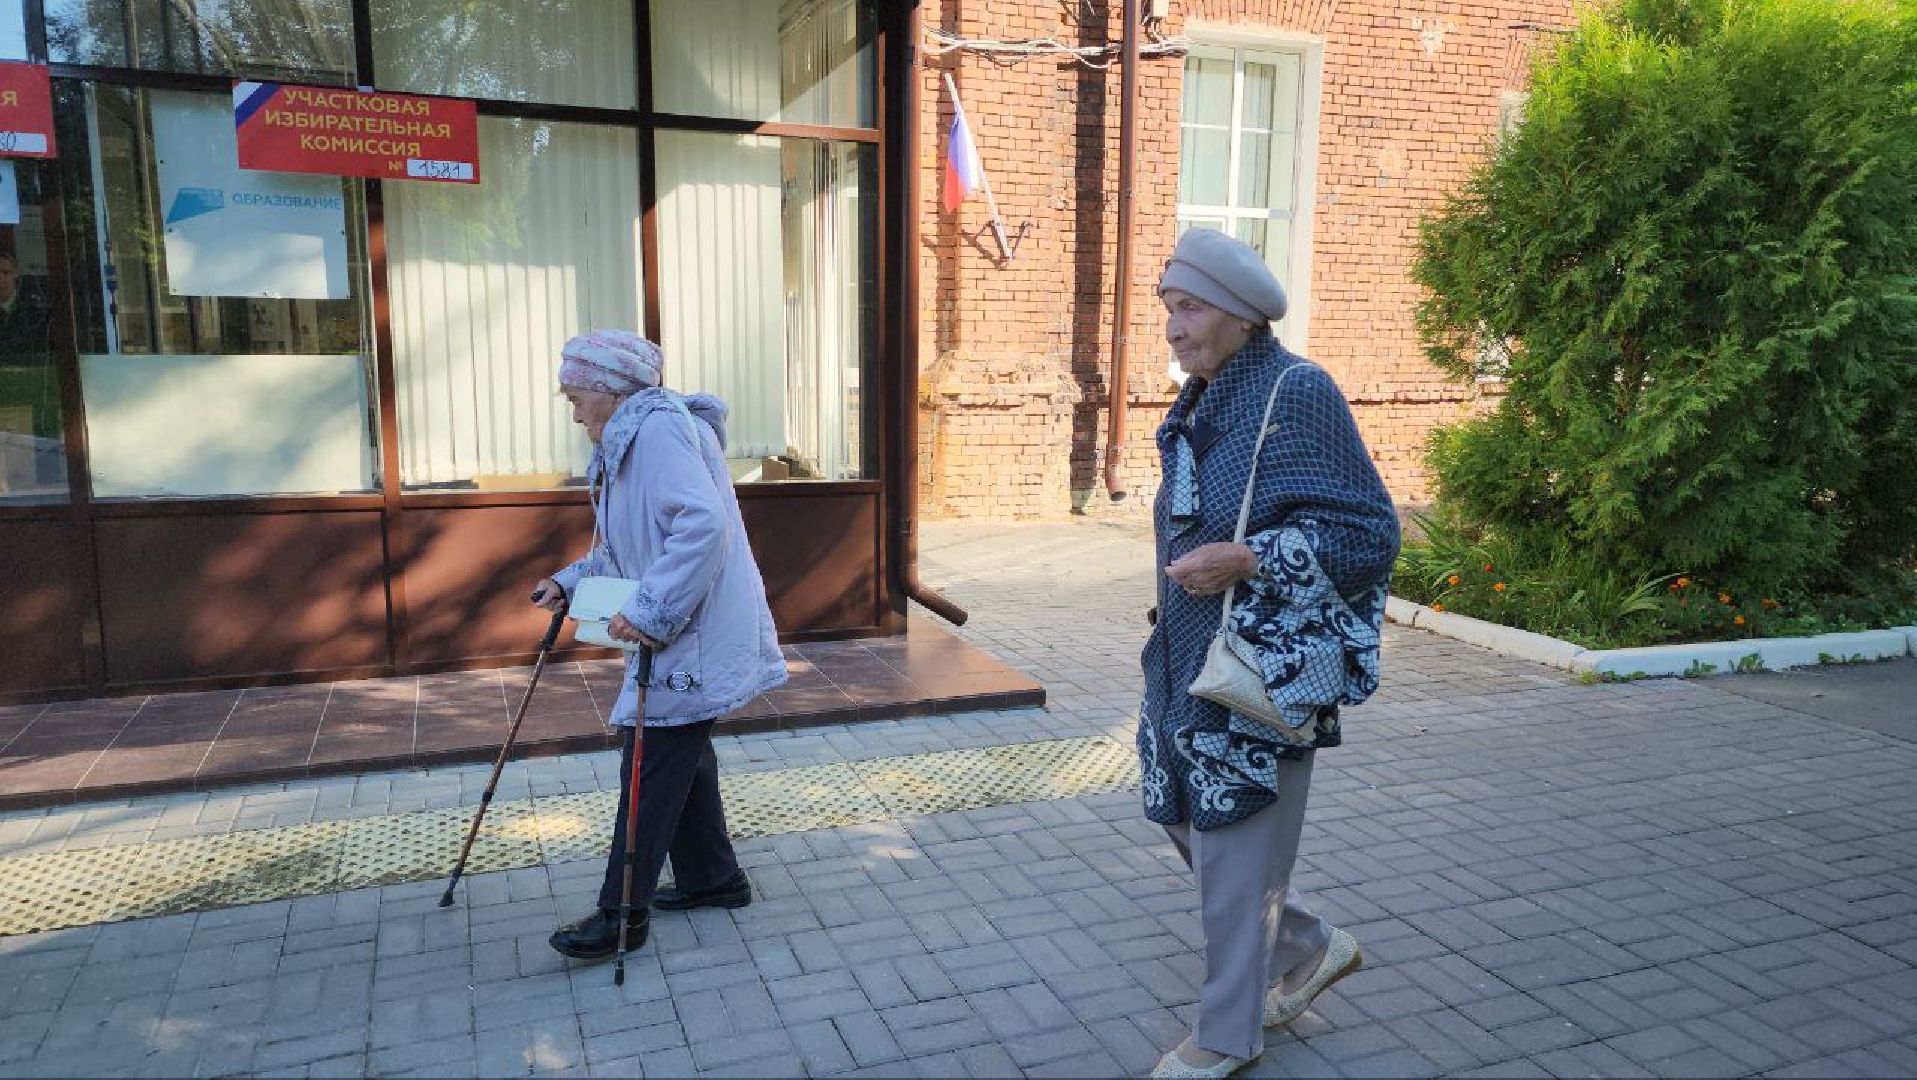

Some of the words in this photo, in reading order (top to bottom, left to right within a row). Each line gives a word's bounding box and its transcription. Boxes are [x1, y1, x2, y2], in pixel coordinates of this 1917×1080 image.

[285, 89, 430, 116] УЧАСТКОВАЯ
[265, 110, 450, 138] ИЗБИРАТЕЛЬНАЯ
[300, 134, 421, 157] КОМИССИЯ
[232, 193, 342, 210] ОБРАЗОВАНИЕ
